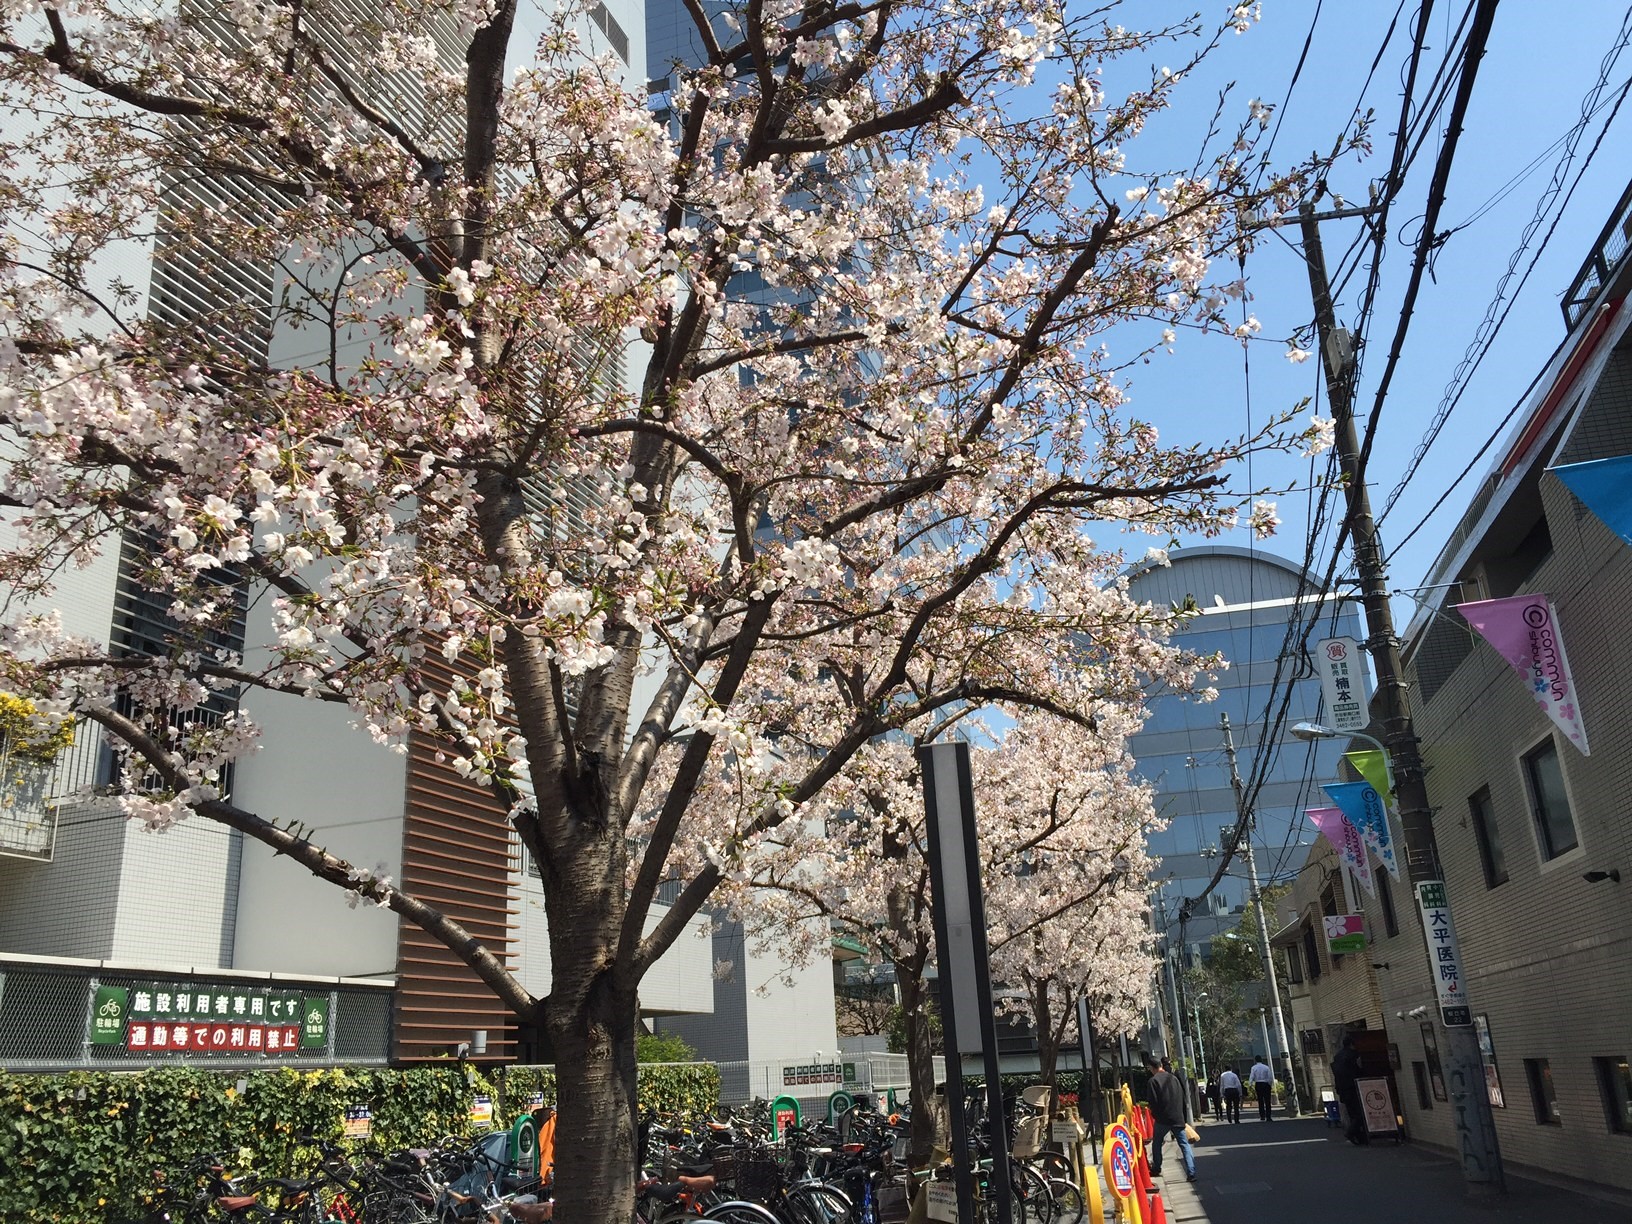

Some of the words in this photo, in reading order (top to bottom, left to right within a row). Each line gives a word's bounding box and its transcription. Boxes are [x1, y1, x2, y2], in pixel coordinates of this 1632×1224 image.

[1330, 645, 1344, 657] 質
[1529, 630, 1543, 678] shibuya
[1540, 629, 1564, 702] commun
[1335, 677, 1352, 703] 楠本
[1372, 803, 1387, 848] commun
[1430, 909, 1459, 981] 大平医院
[133, 990, 298, 1016] 施設利用者専用です
[96, 1018, 120, 1028] 駐輪場
[306, 1024, 323, 1034] 駐輪場
[131, 1025, 297, 1049] 通勤等での利用禁止
